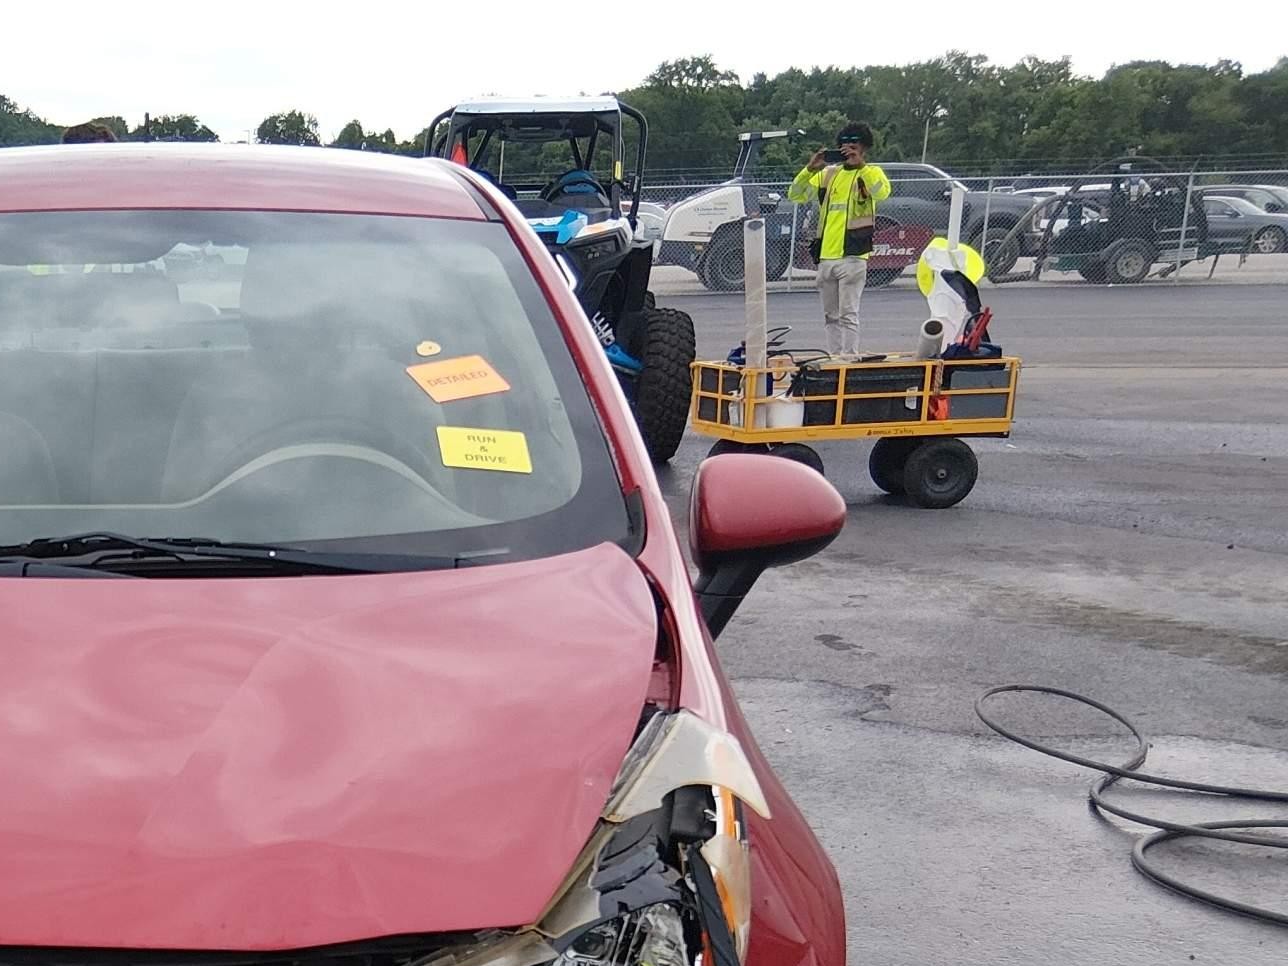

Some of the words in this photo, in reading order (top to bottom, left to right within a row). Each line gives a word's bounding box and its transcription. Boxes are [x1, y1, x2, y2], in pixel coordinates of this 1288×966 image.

[426, 371, 488, 387] DETAILED
[467, 435, 497, 444] RUN
[465, 454, 507, 463] DRIVE
